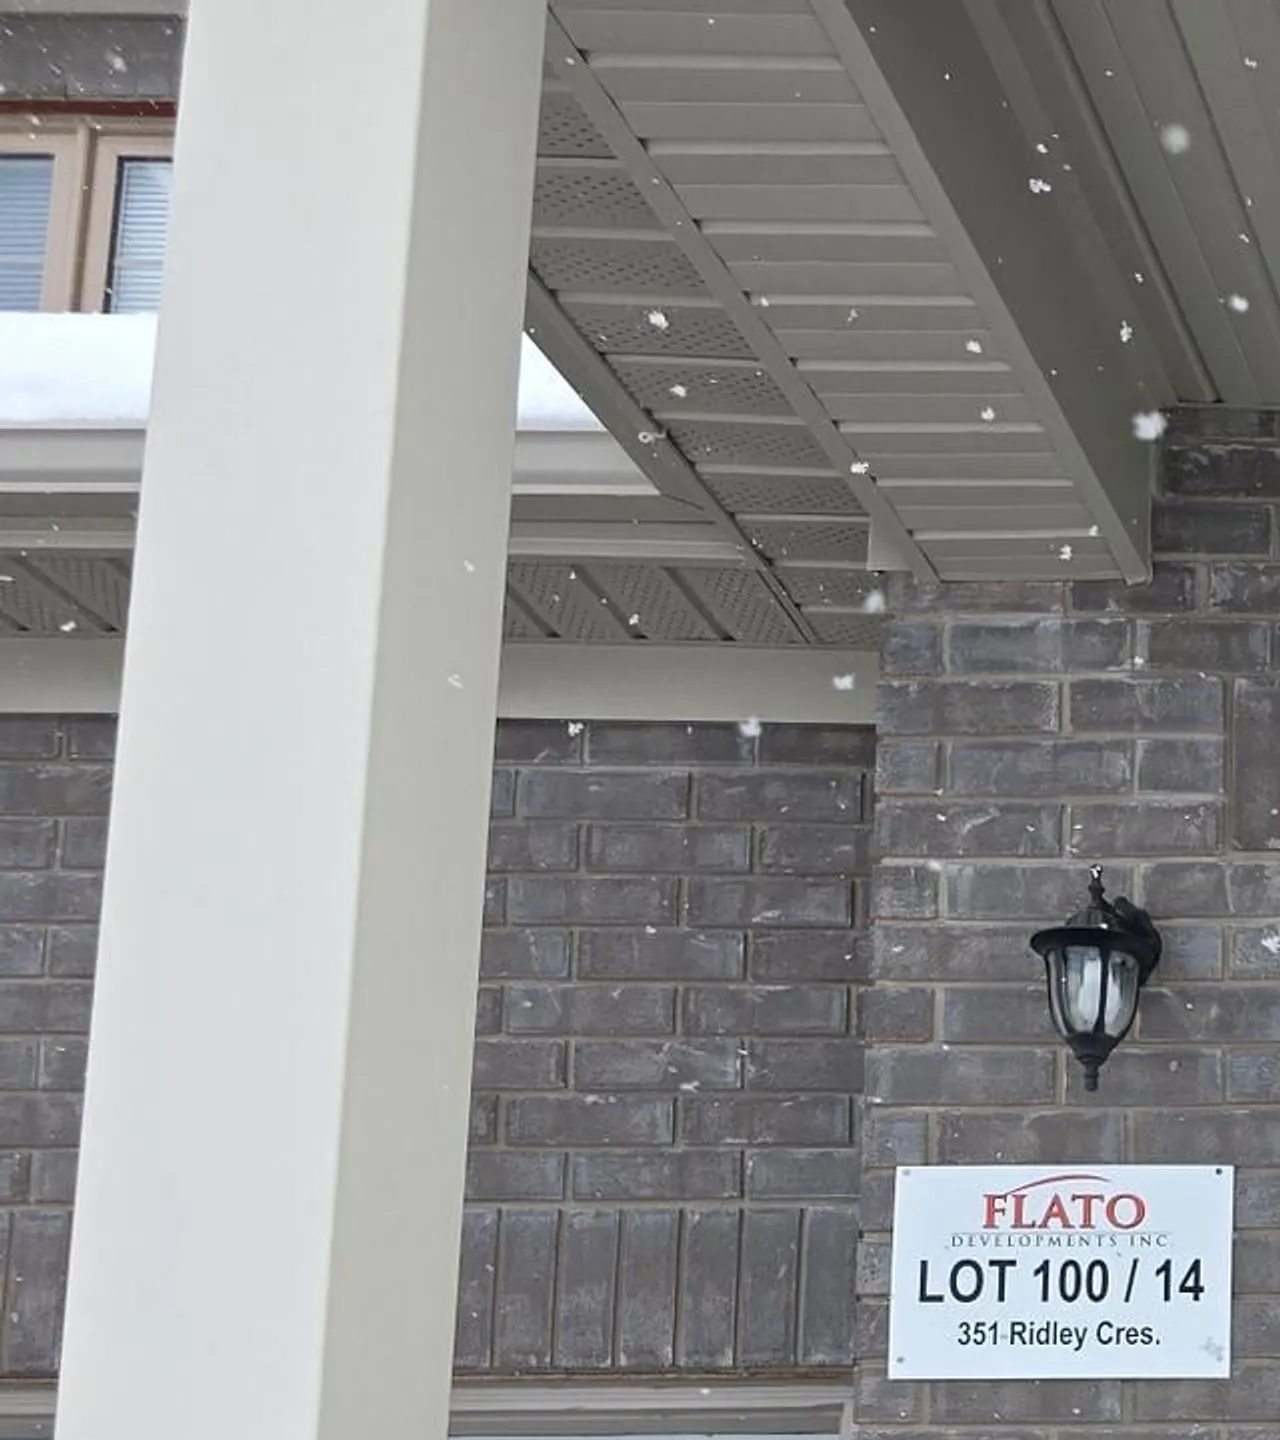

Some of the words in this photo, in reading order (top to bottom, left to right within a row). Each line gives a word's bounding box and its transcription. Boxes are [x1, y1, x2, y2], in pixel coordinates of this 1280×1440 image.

[982, 1192, 1146, 1230] FLATO
[951, 1233, 1118, 1248] DEVELOPMENTS
[918, 1258, 1018, 1304] LOT
[1033, 1258, 1109, 1304] 100
[1123, 1257, 1139, 1303] /
[1155, 1258, 1206, 1303] 14
[957, 1321, 999, 1346] 351
[1009, 1320, 1088, 1352] Ridley
[1095, 1320, 1162, 1346] Cres.
